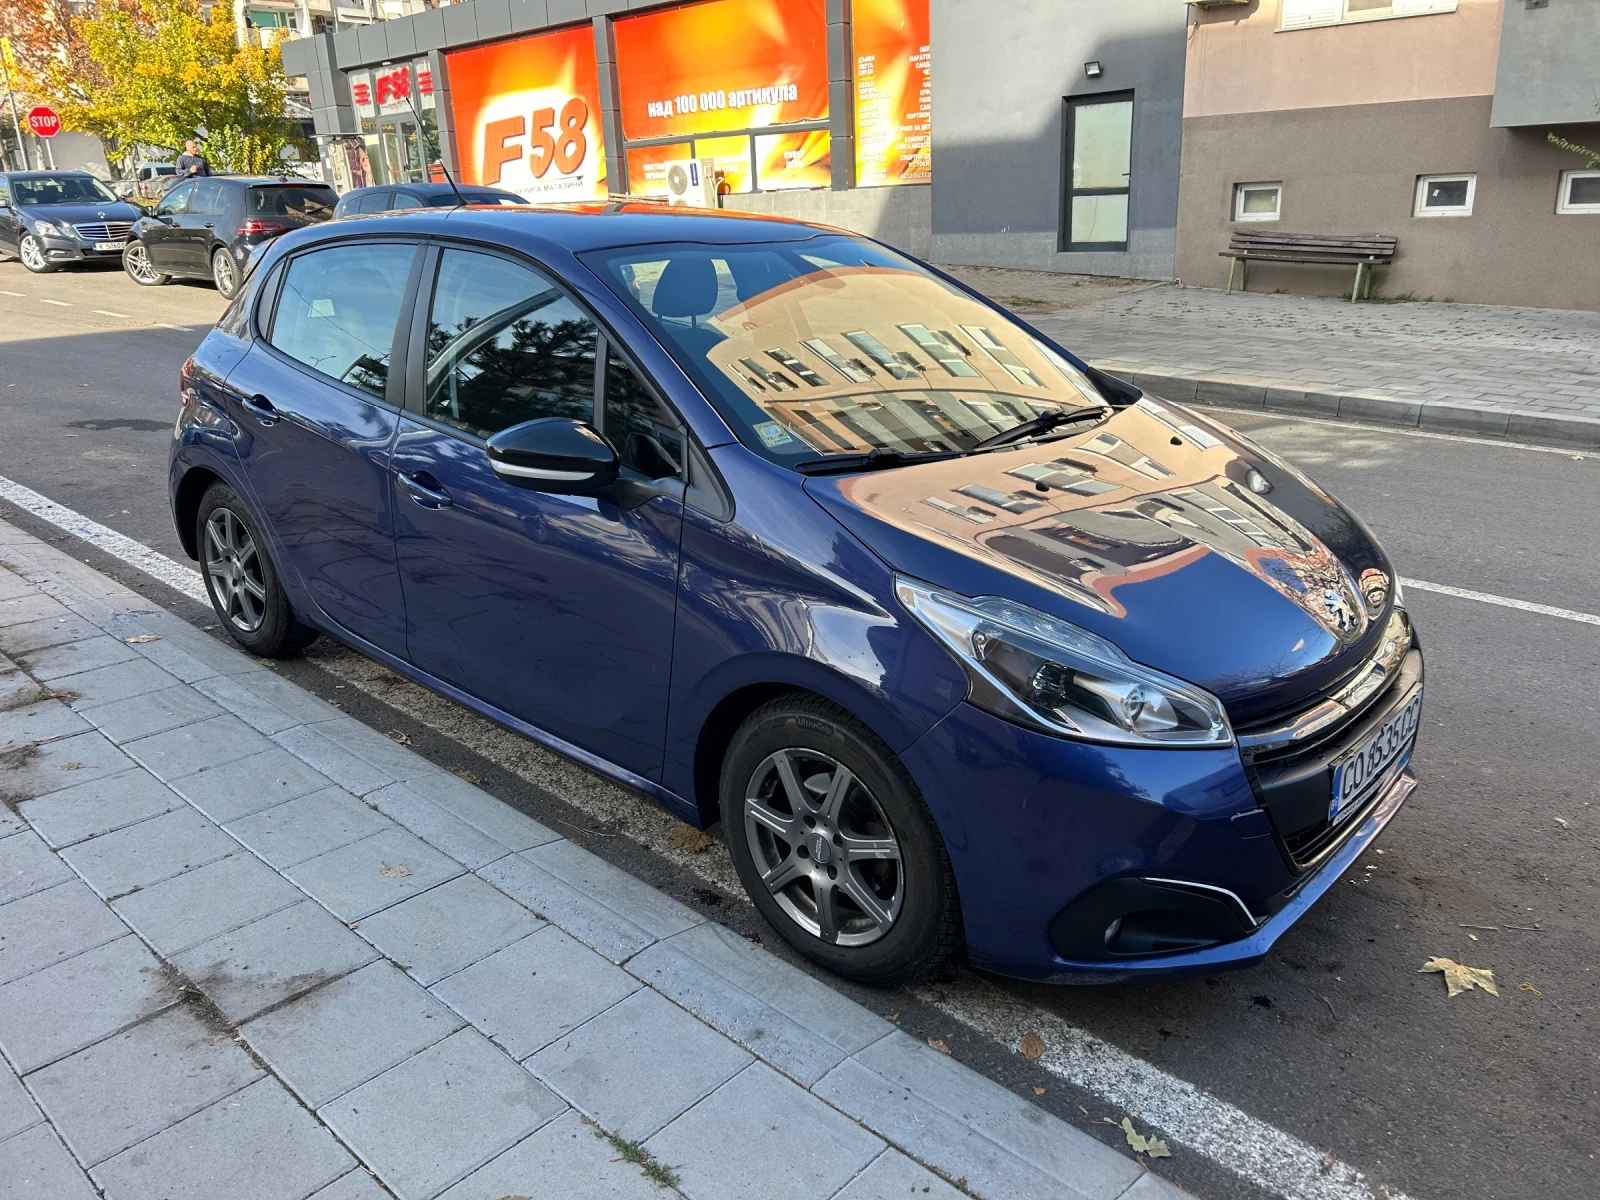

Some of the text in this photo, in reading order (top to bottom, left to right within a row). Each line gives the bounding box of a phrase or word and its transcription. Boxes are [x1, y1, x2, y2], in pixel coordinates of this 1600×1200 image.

[376, 66, 410, 105] F58
[647, 84, 798, 118] над 100 000 артикула
[31, 116, 57, 127] STOP
[482, 97, 589, 187] F58
[514, 181, 583, 195] ВЕРИГА МАГАЗИНИ
[797, 717, 832, 736] UltraGrip
[1342, 751, 1364, 800] CO
[1366, 714, 1401, 778] 8535
